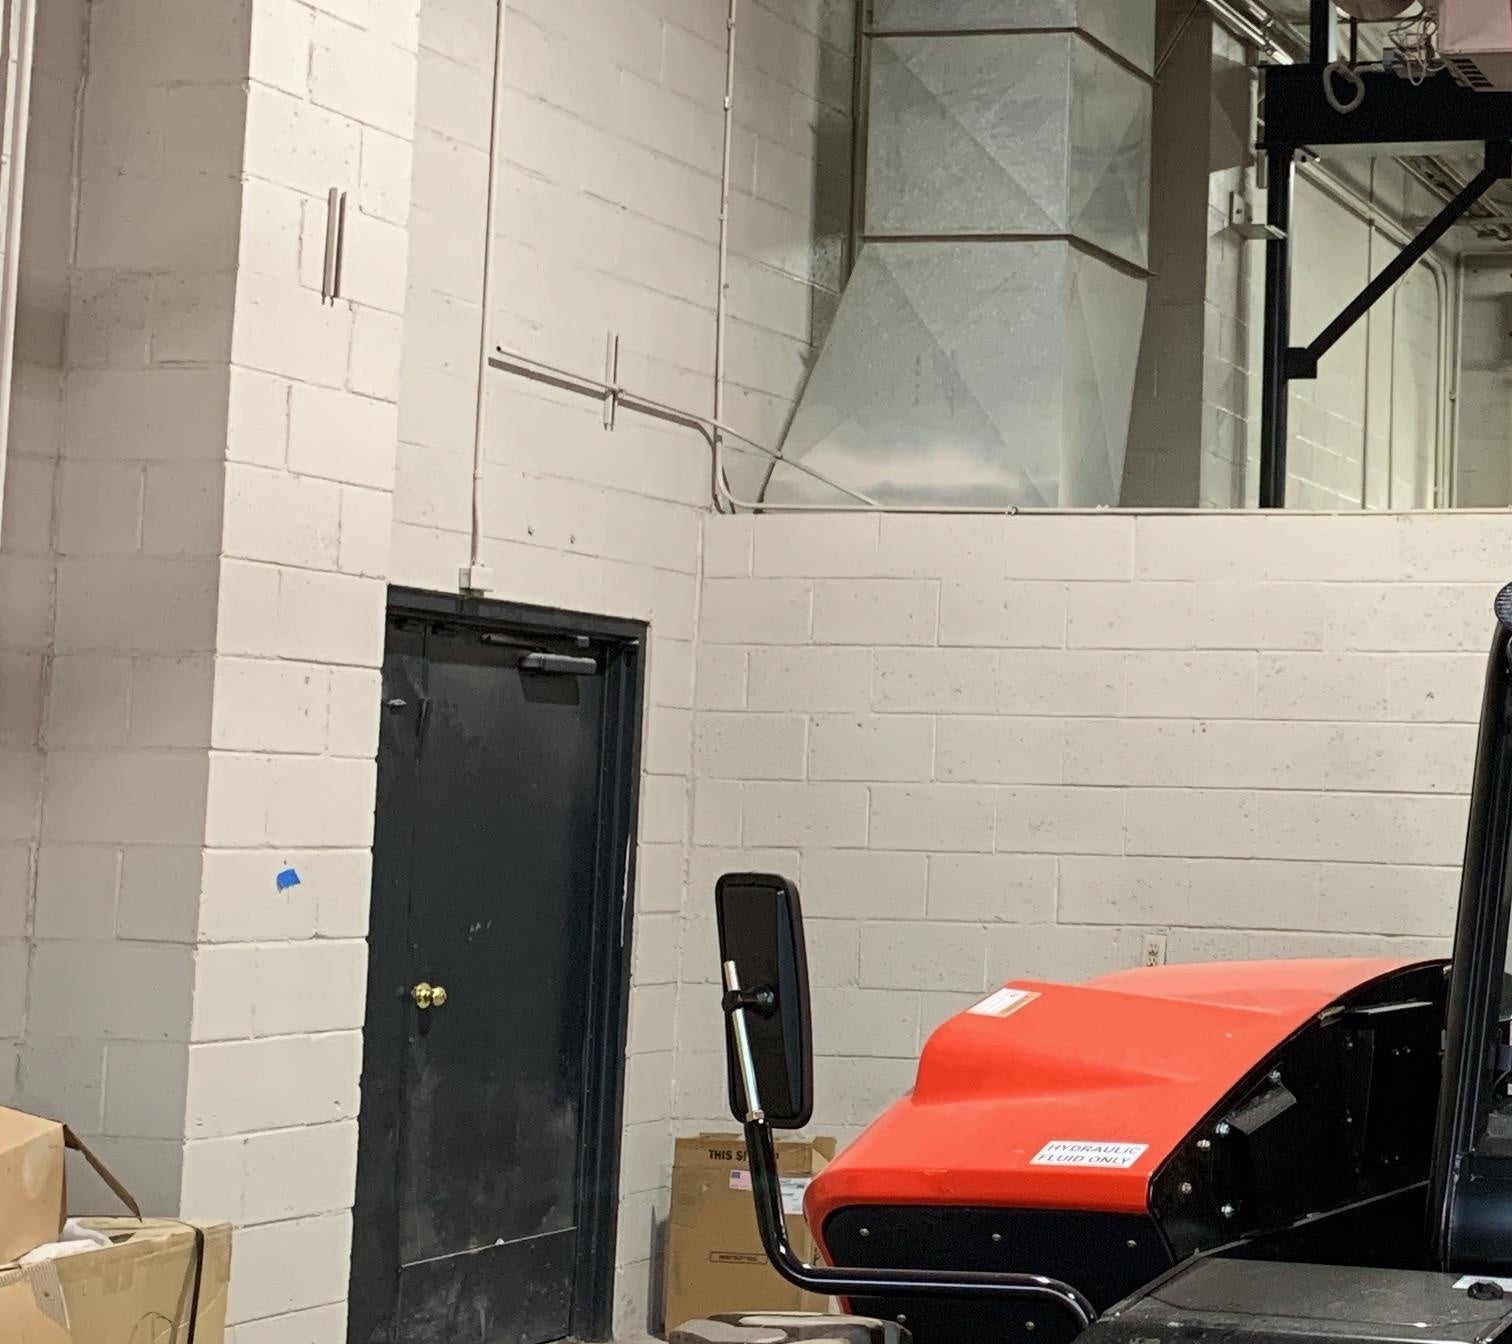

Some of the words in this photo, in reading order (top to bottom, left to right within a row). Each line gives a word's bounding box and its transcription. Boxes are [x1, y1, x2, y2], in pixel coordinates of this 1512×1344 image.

[708, 1149, 733, 1160] THIS
[1046, 1144, 1142, 1155] HYDRAULIC
[1037, 1154, 1085, 1162] FLUID
[1088, 1155, 1132, 1164] ONLY
